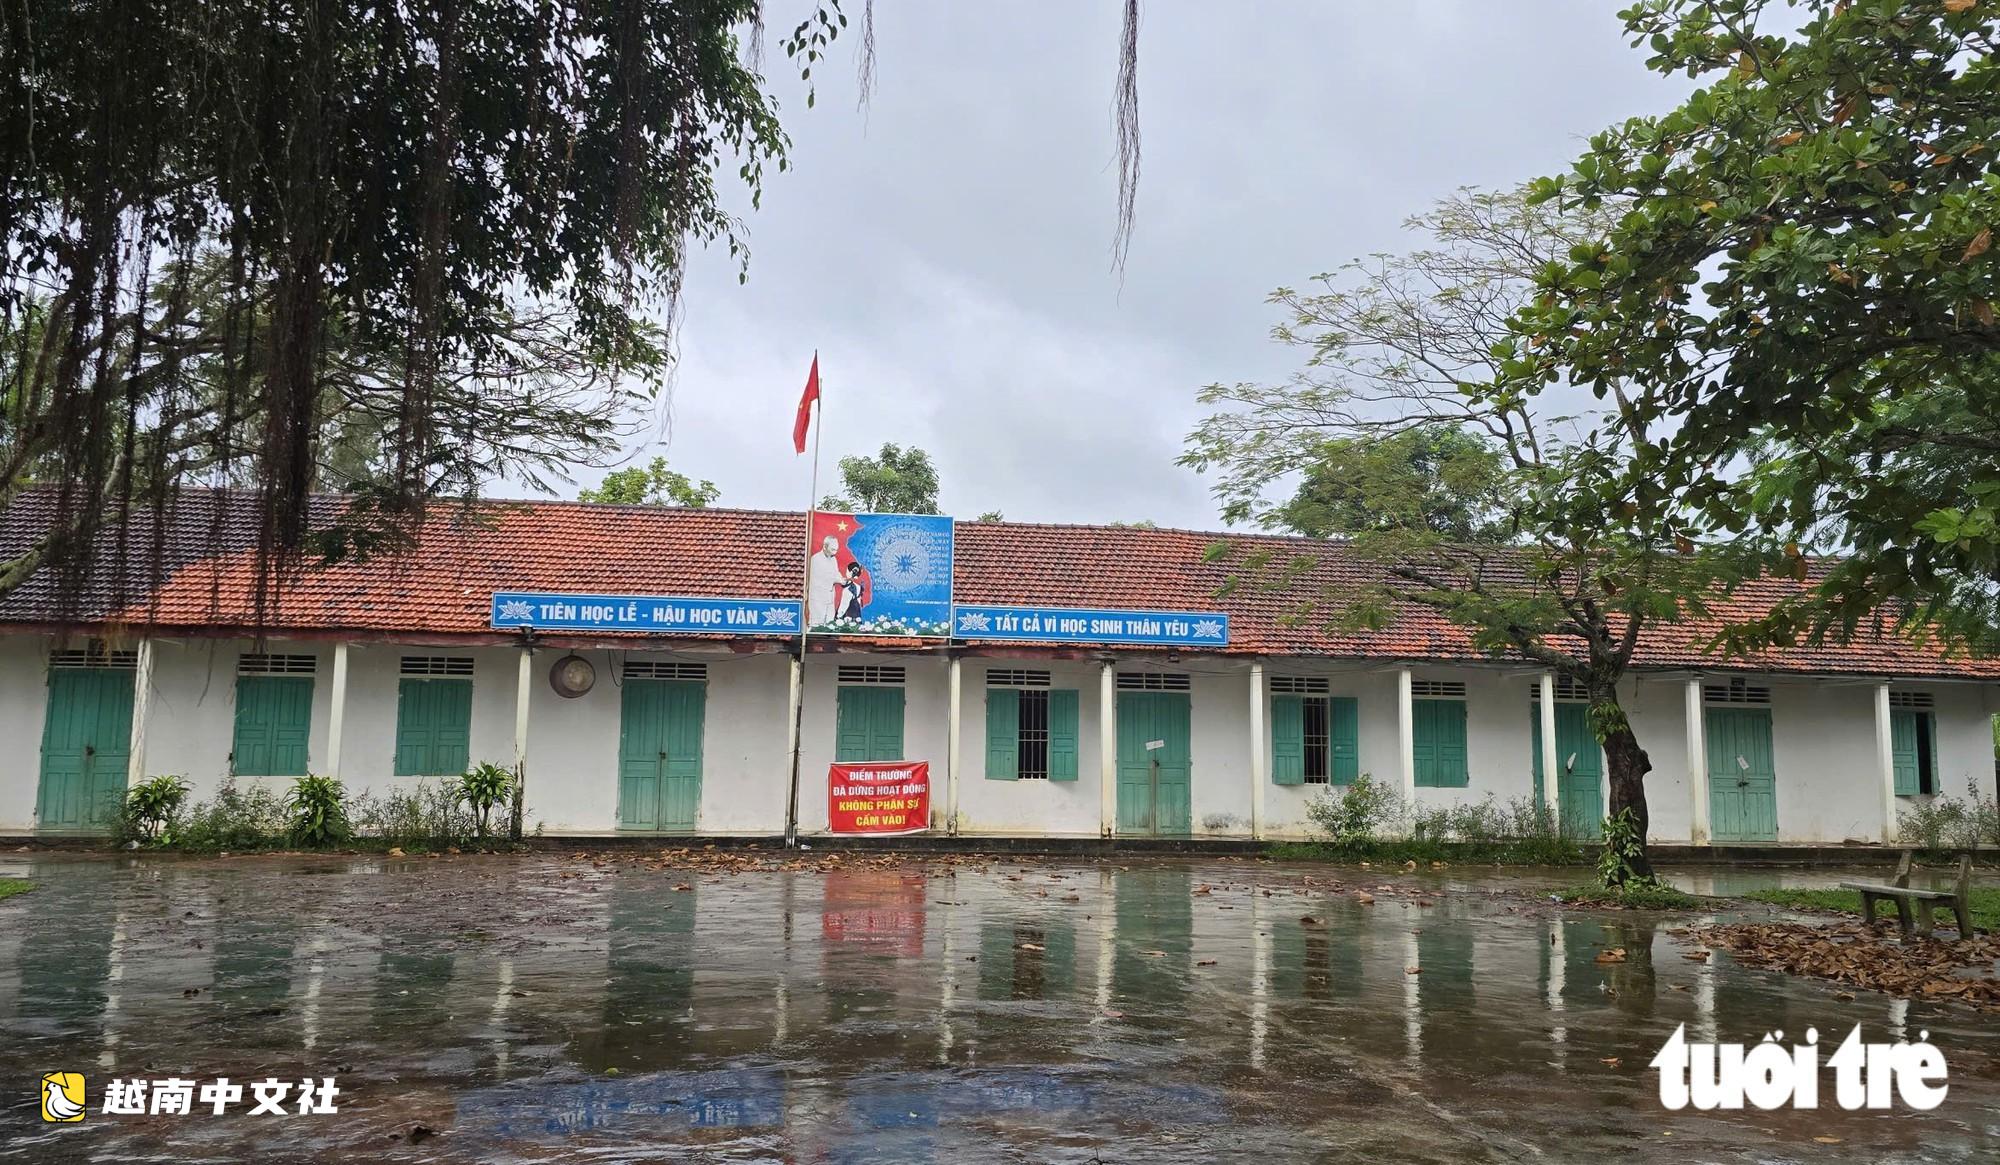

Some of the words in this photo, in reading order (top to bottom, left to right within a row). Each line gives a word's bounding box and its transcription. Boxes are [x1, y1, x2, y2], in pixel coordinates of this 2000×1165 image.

[540, 603, 576, 620] TIÊN
[581, 605, 614, 624] HỌC
[618, 601, 637, 622] LỄ
[653, 605, 684, 628] HẬU
[690, 608, 722, 627] HỌC
[726, 607, 758, 625] VĂN
[995, 612, 1019, 632] TẤT
[1023, 613, 1040, 632] CẢ
[1044, 615, 1057, 633] VÌ
[1060, 618, 1087, 636] HỌC
[1091, 619, 1123, 635] SINH
[1126, 617, 1161, 636] THÂN
[1164, 617, 1188, 637] YÊU
[849, 768, 873, 780] ĐIỂM
[876, 769, 912, 780] TRƯỜNG
[833, 785, 846, 796] ĐÃ
[876, 785, 900, 797] HOẠT
[902, 783, 926, 796] ĐỘNG
[839, 800, 874, 811] KHÔNG
[876, 799, 905, 812] PHẬN
[856, 814, 879, 826] CẤM
[882, 815, 905, 825] VÀO!
